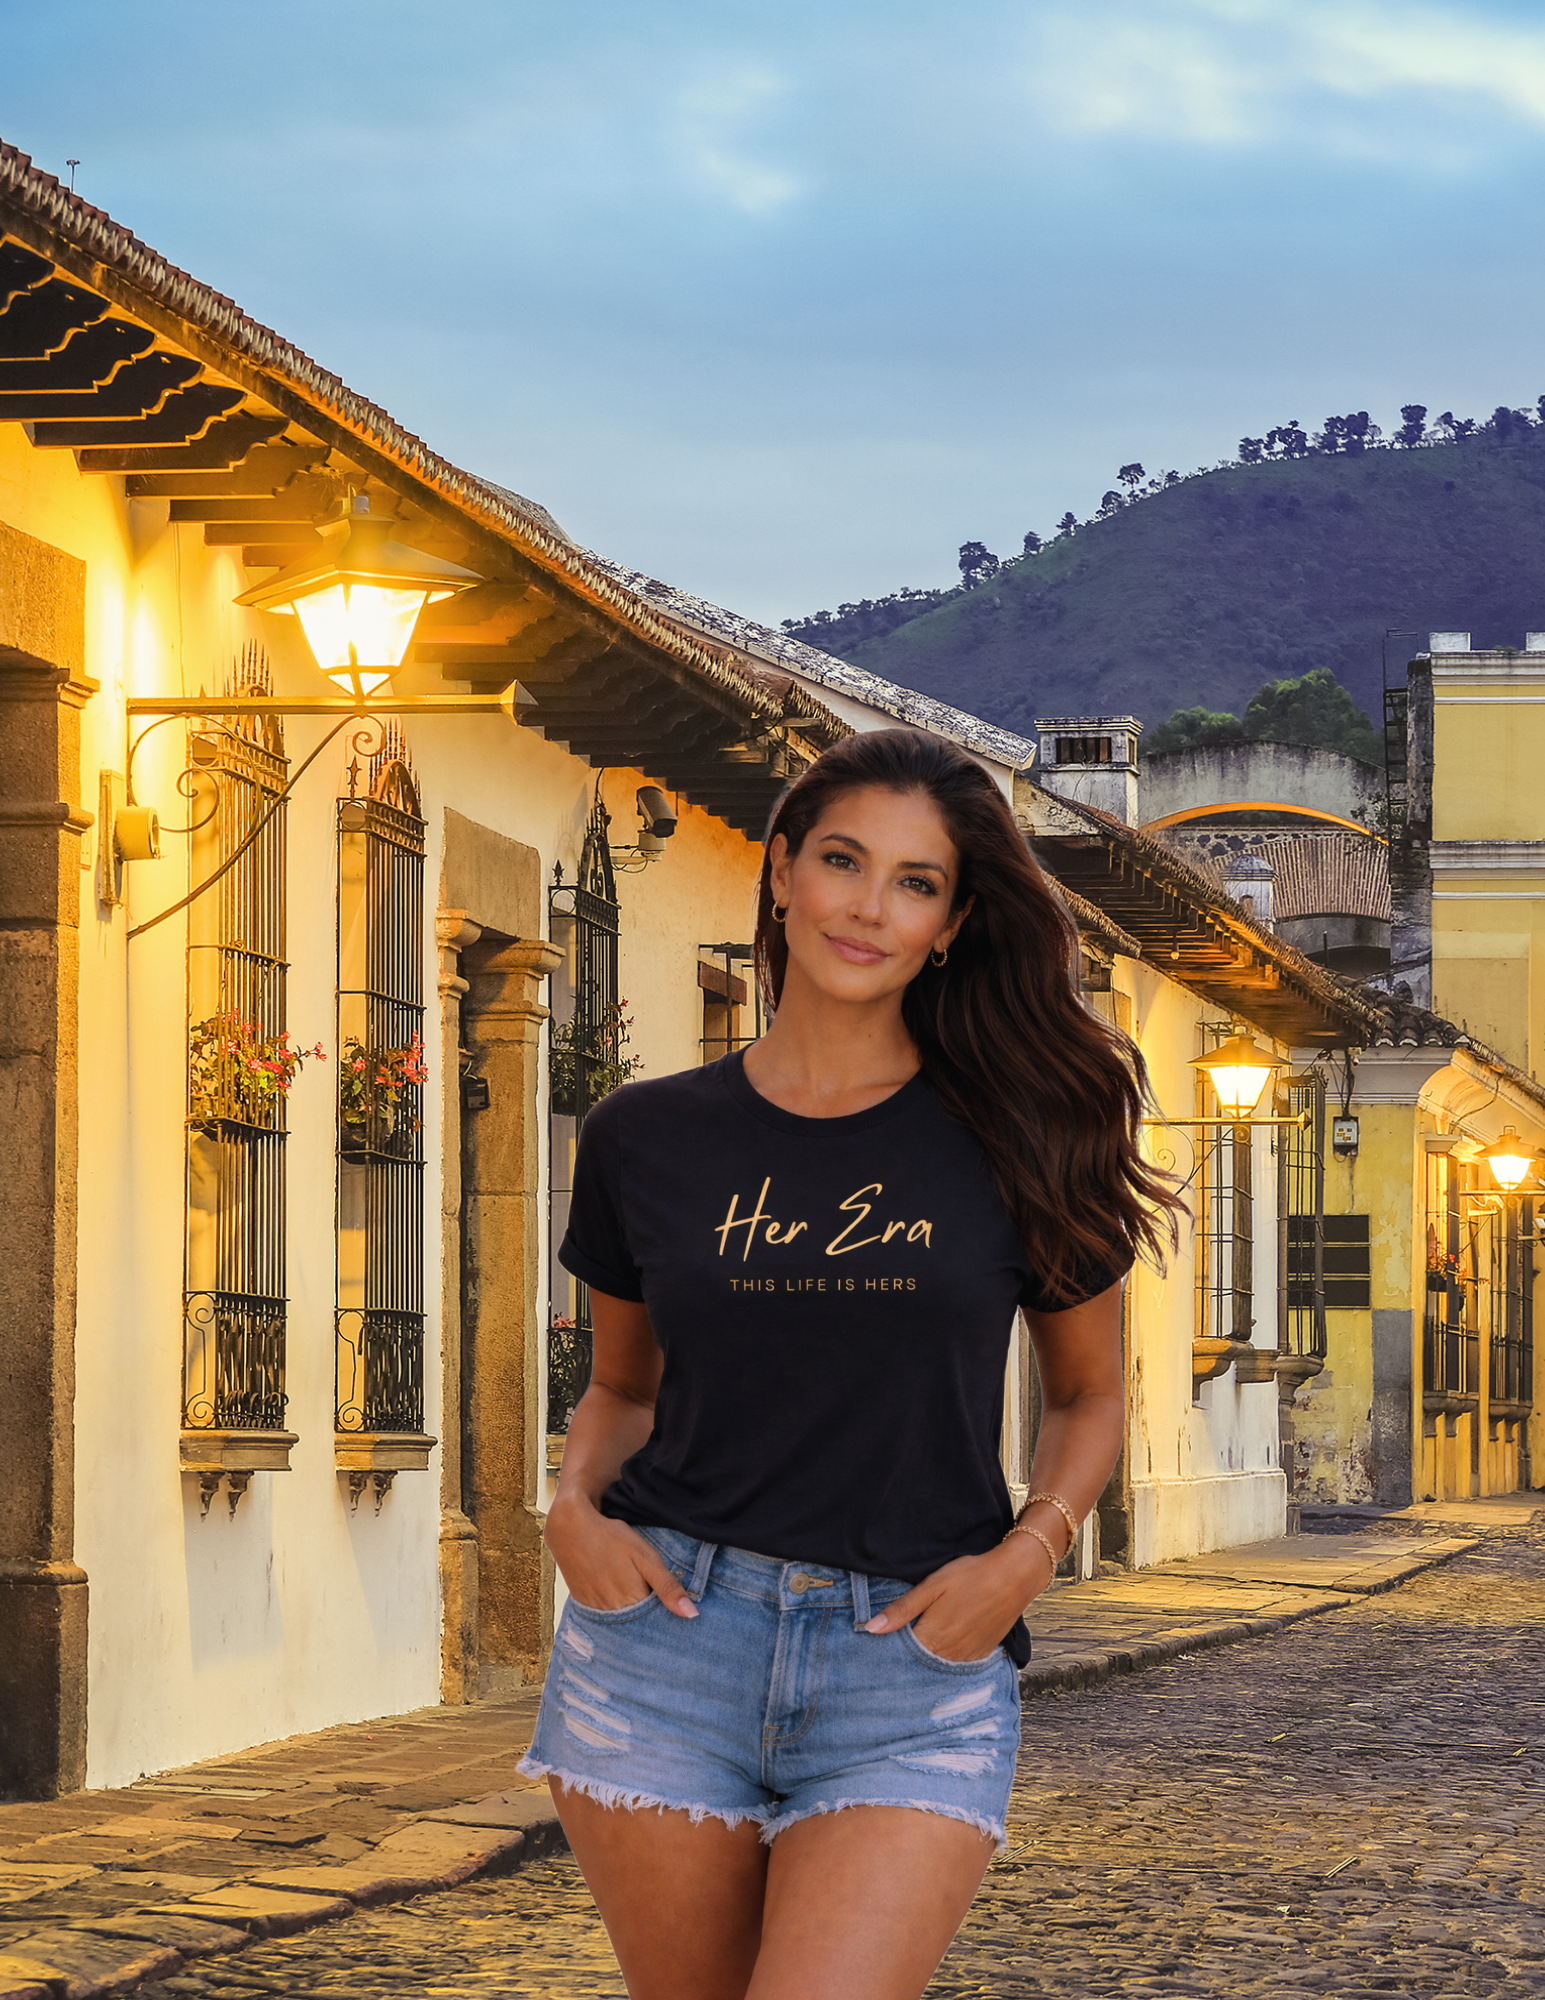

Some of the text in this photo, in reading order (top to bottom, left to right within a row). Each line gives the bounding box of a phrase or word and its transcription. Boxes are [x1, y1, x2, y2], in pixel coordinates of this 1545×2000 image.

[714, 1176, 933, 1262] Her Era
[730, 1278, 917, 1291] THIS LIFE IS HERS
